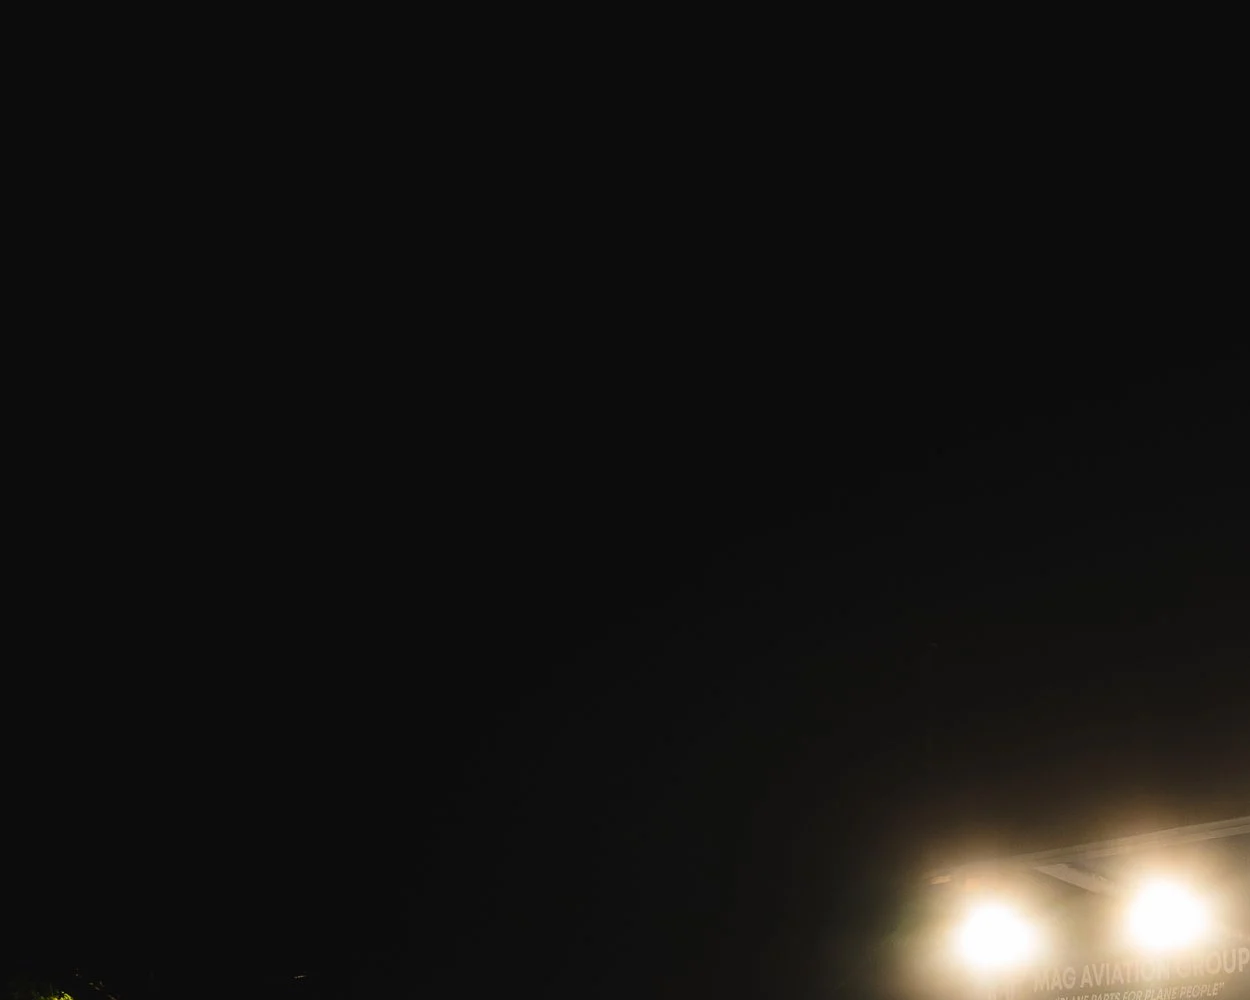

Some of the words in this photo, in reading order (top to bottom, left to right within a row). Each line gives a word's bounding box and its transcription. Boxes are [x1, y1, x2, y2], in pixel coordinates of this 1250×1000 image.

[1033, 966, 1077, 993] MAG
[1080, 958, 1171, 989] AVIATION
[1177, 946, 1250, 976] GROUP
